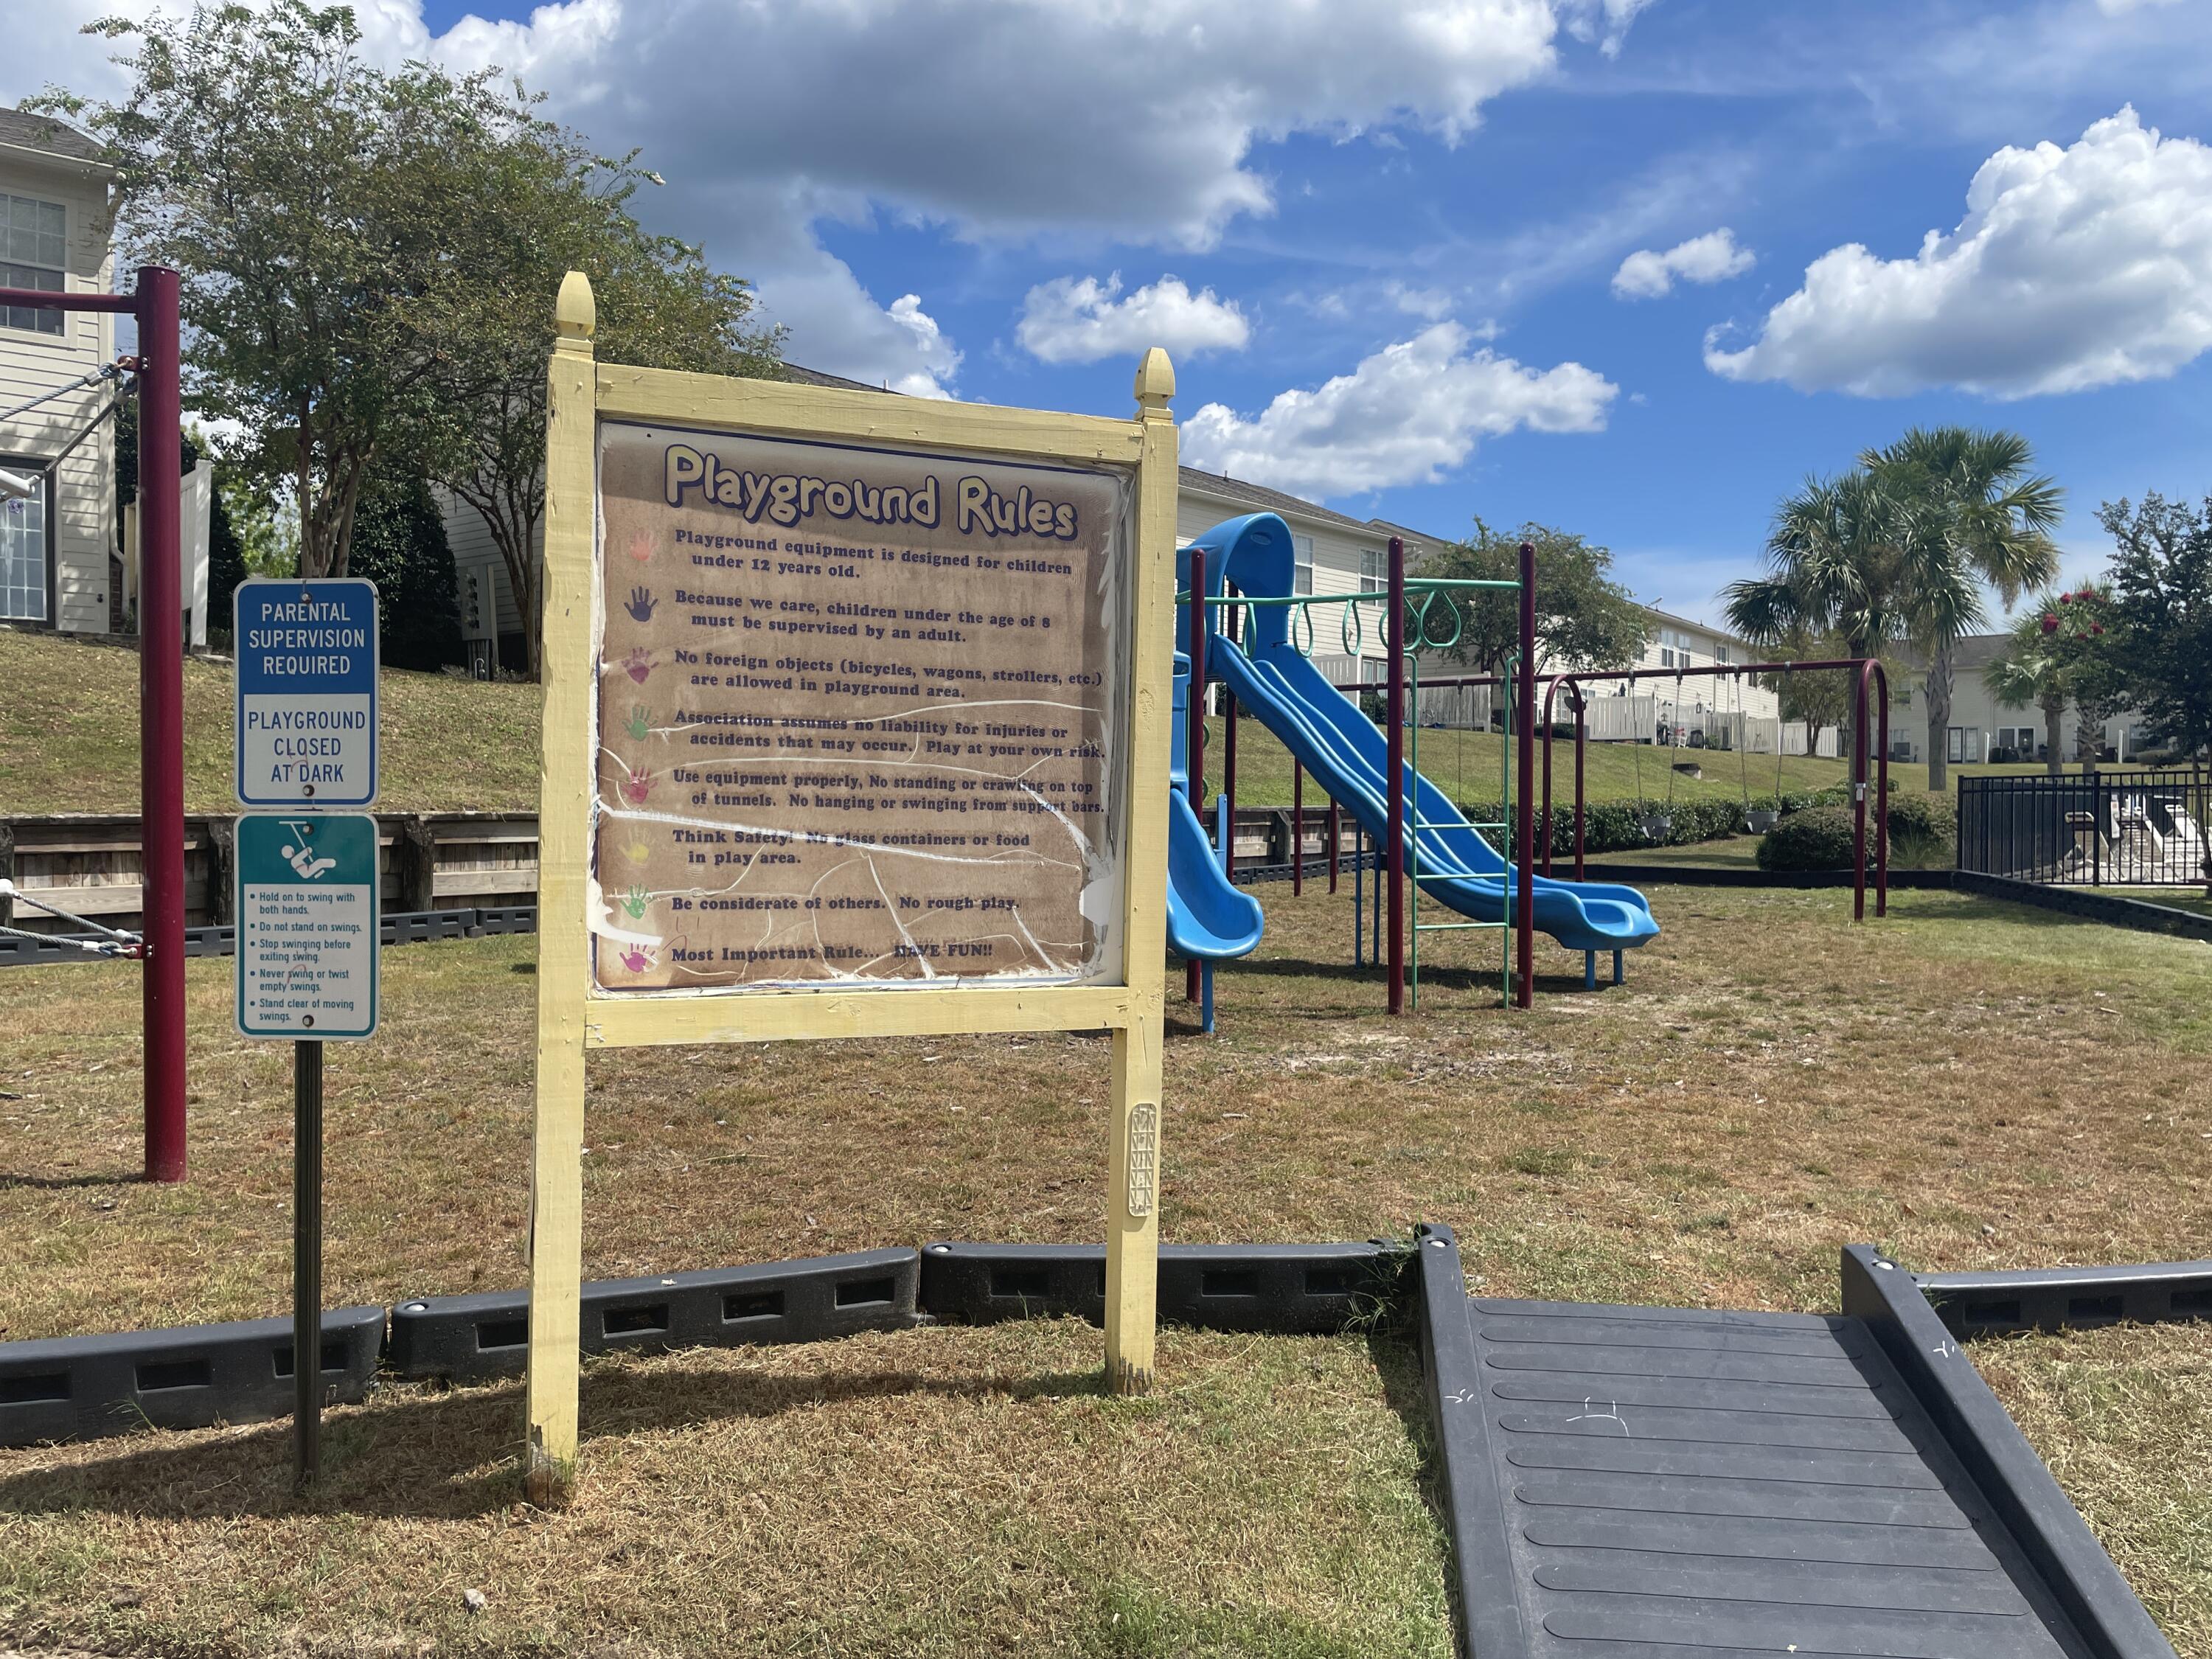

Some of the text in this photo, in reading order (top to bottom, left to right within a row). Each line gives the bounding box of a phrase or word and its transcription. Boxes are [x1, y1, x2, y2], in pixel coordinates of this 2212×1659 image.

[665, 444, 1078, 540] Playground Rules
[675, 529, 1071, 574] Playground equipment is designed for children
[692, 554, 860, 578] under 12 years old.
[262, 602, 351, 622] PARENTAL
[675, 590, 1051, 628] Because we care, children under the age of 8
[692, 614, 967, 642] must be supervised by an adult.
[248, 629, 364, 648] SUPERVISION
[263, 655, 351, 675] REQUIRED
[675, 650, 1102, 686] No foreign objects (bicycles, wagons, strollers, etc.)
[691, 675, 965, 698] are allowed in playground area.
[248, 711, 366, 730] PLAYGROUND
[674, 709, 1068, 738] Association assumes no liability for injuries or
[274, 737, 341, 757] CLOSED
[690, 733, 1105, 758] accidents that may occur. Play at your own risk.
[271, 764, 344, 782] AT DARK
[673, 769, 699, 783] Use
[706, 772, 787, 786] equipment
[794, 775, 863, 790] properly,
[869, 775, 888, 787] No
[894, 777, 956, 791] standing
[961, 780, 977, 790] or
[1049, 782, 1065, 792] on
[1071, 780, 1093, 794] top
[692, 793, 707, 804] of
[714, 793, 776, 807] tunnels.
[789, 794, 809, 807] No
[815, 795, 874, 810] hanging
[880, 798, 897, 809] or
[902, 797, 967, 812] swinging
[973, 799, 1007, 811] from
[1072, 800, 1105, 813] bars.
[672, 830, 727, 843] Think
[835, 832, 875, 846] glass
[882, 834, 966, 846] containers
[973, 836, 989, 846] or
[995, 835, 1029, 846] food
[689, 851, 801, 866] in play area.
[260, 892, 355, 904] Hold on to swing with
[672, 897, 1020, 911] Be considerate of others. No rough play.
[260, 905, 279, 914] both
[260, 922, 270, 931] Do
[274, 922, 288, 931] not
[291, 922, 314, 931] stand
[331, 922, 362, 934] swings.
[260, 939, 351, 951] Stop swinging before
[672, 948, 714, 961] Most
[722, 947, 816, 962] Important
[823, 946, 880, 959] Rule...
[947, 944, 992, 956] FUN!!
[260, 951, 289, 964] exiting
[260, 968, 349, 981] Never swing or twist
[260, 981, 321, 993] empty swings.
[260, 998, 354, 1011] Stand clear of moving
[260, 1012, 291, 1023] swings.
